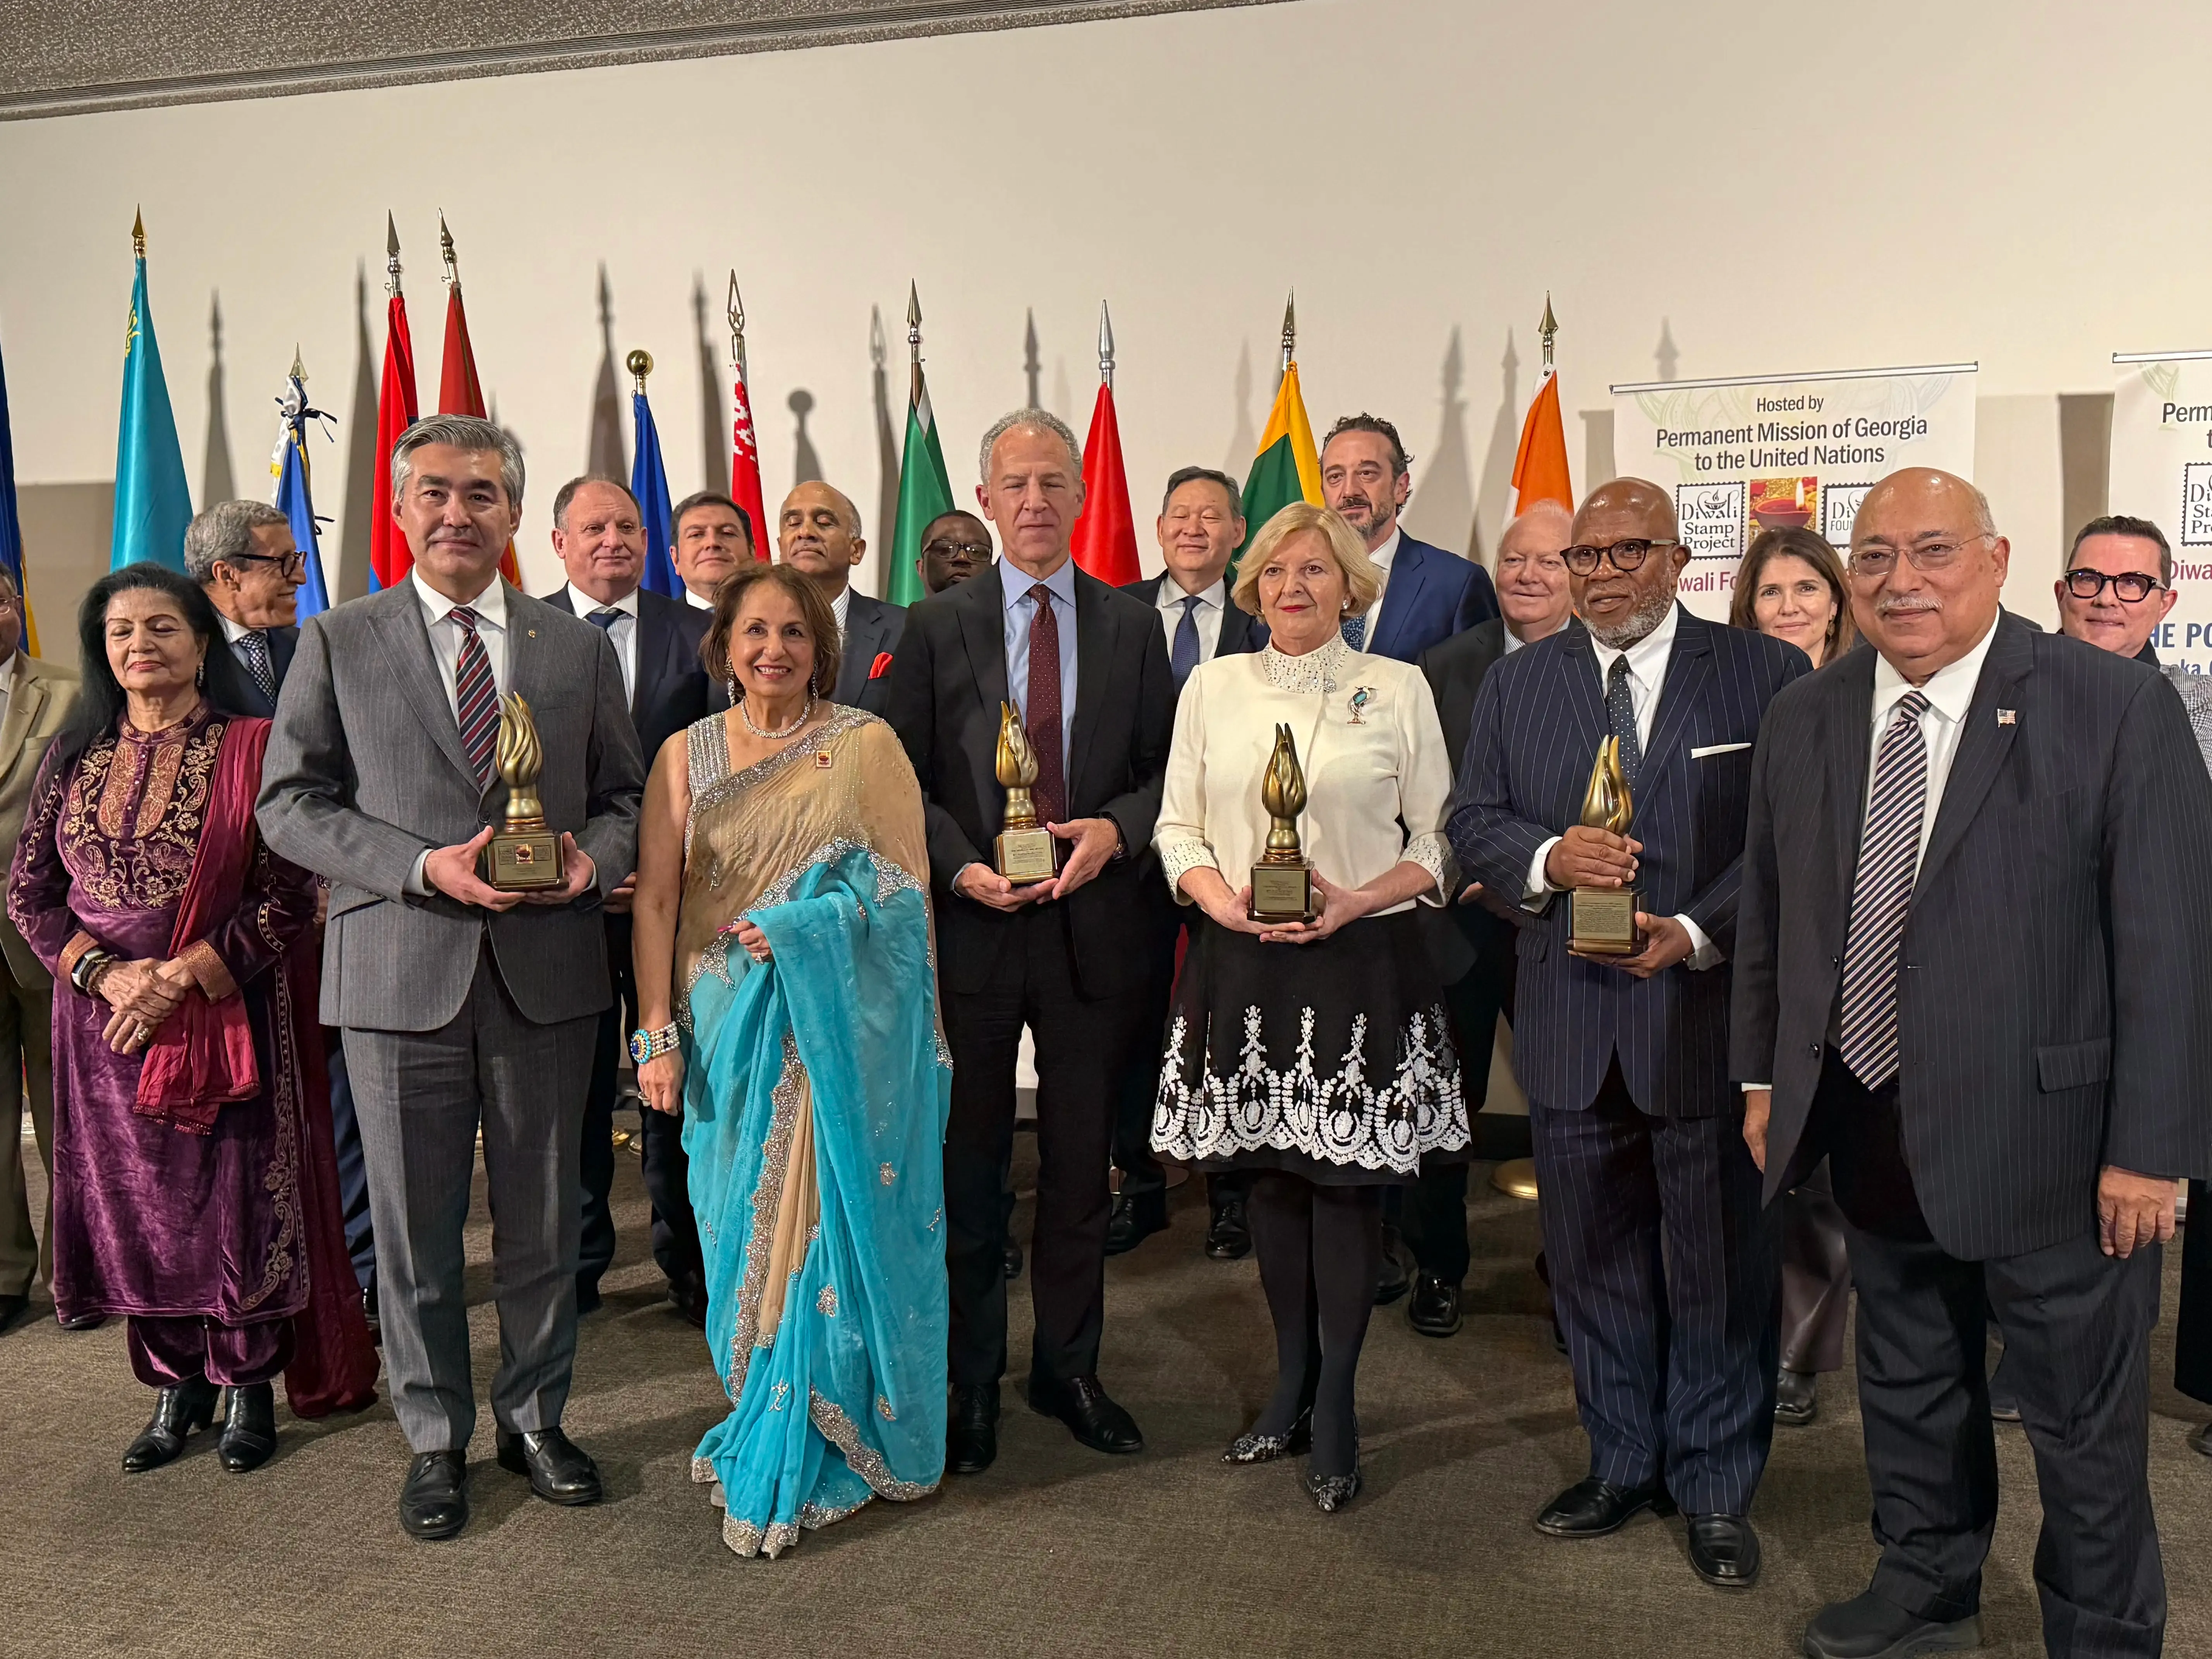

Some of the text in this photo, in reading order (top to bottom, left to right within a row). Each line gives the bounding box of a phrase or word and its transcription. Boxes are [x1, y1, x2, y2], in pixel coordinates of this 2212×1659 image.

[1757, 395, 1824, 412] Hosted by
[1656, 416, 1928, 448] Permanent Mission of Georgia
[1695, 444, 1885, 471] to the United Nations
[1682, 489, 1739, 520] Diwali
[2193, 504, 2212, 518] St
[1684, 522, 1734, 538] Stamp
[2191, 520, 2212, 534] Pr
[1683, 536, 1735, 553] Project
